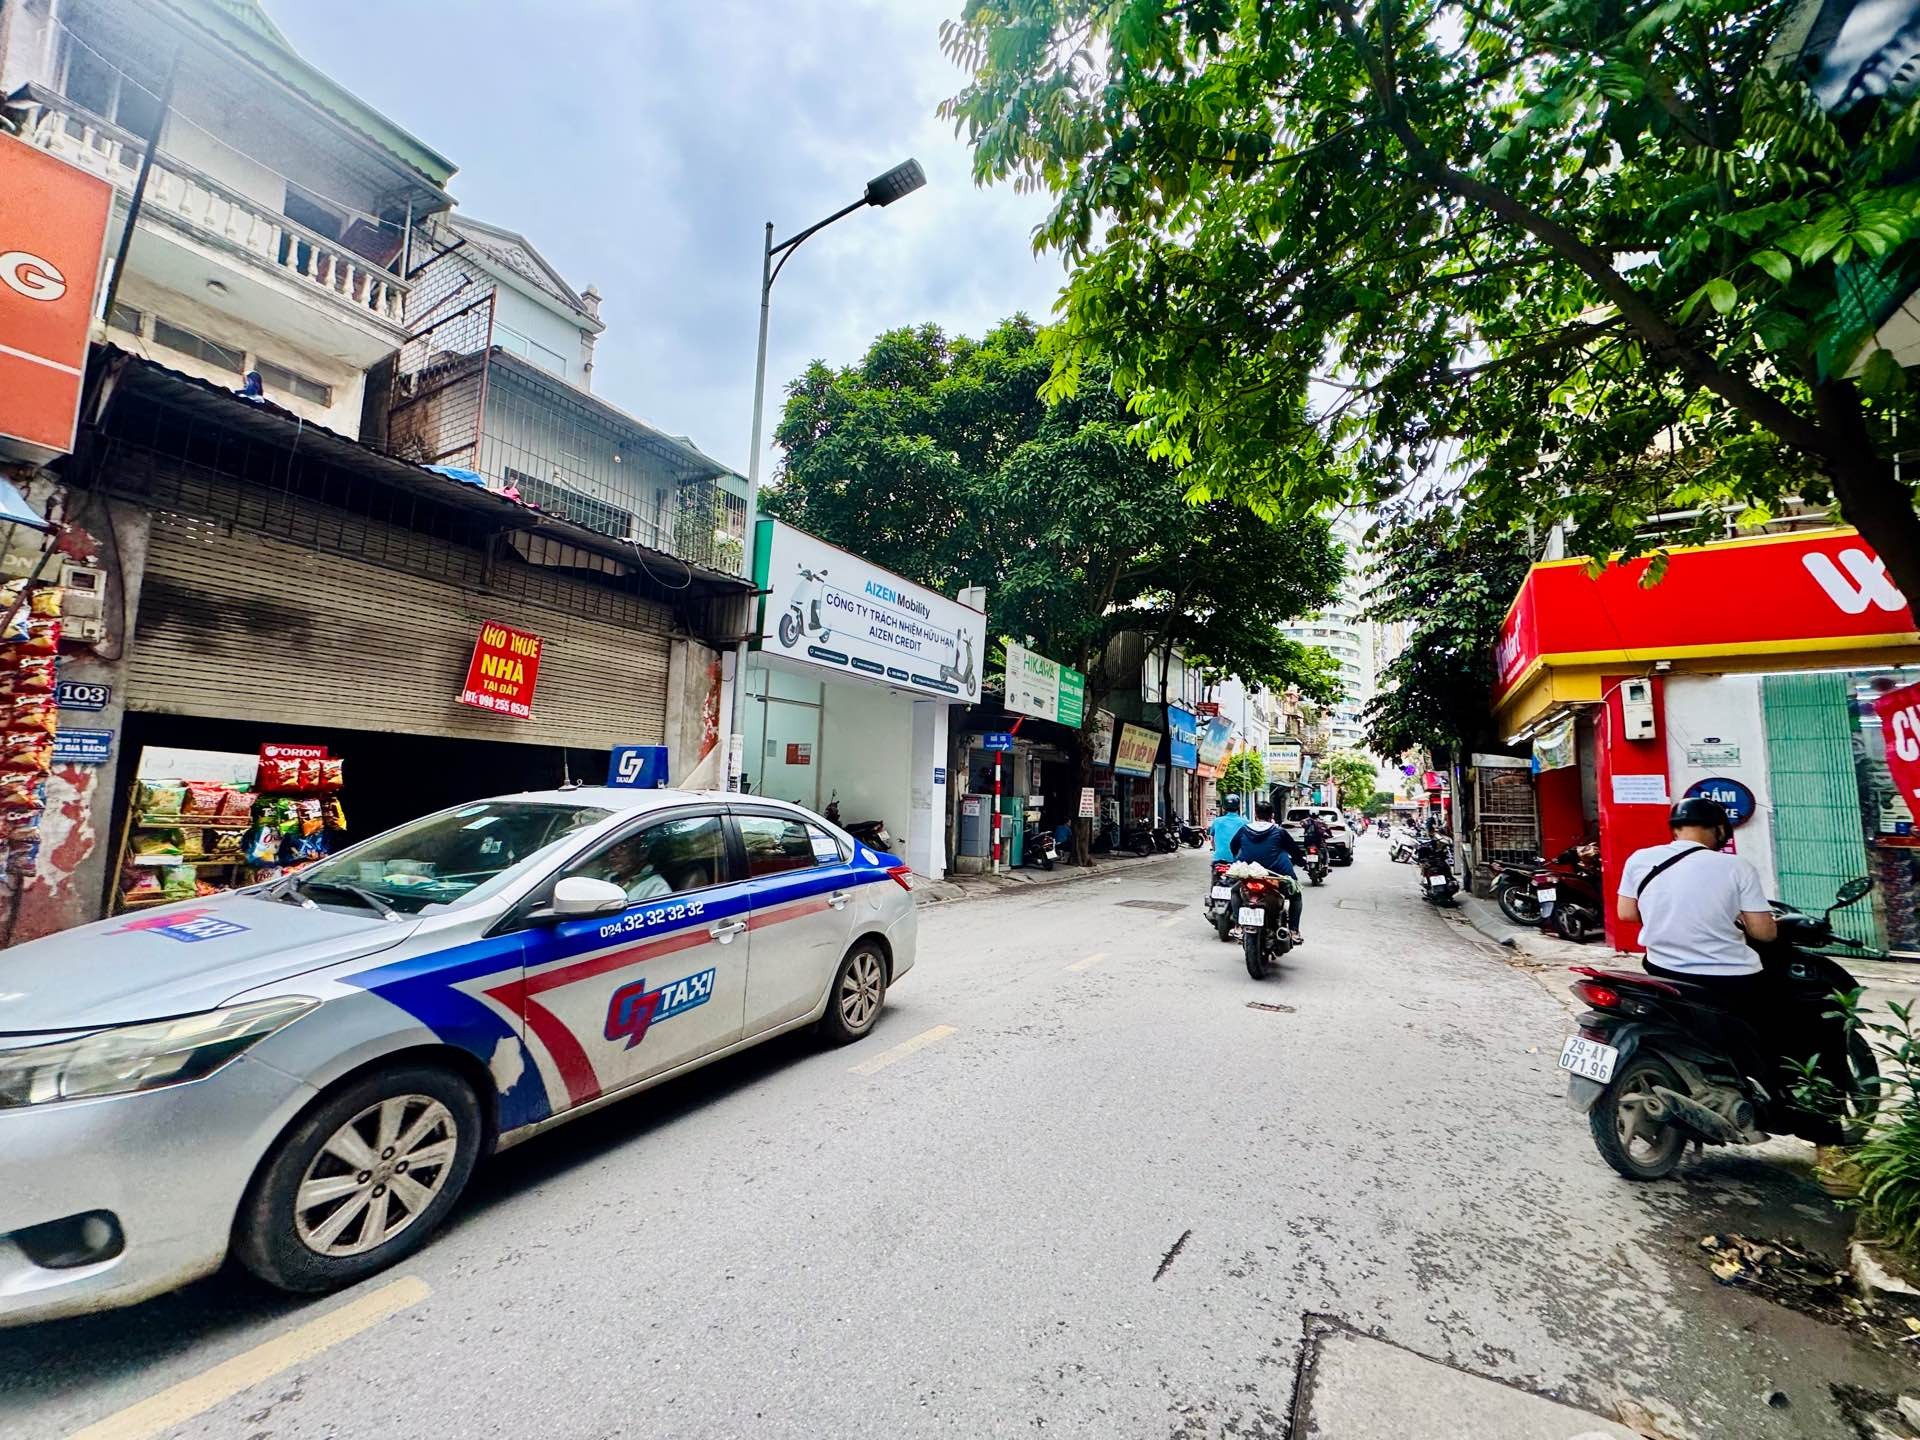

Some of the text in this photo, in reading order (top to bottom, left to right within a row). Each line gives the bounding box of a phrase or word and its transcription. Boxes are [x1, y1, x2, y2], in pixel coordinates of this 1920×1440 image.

[0, 251, 67, 301] G
[864, 579, 931, 620] AIZEN Mobility
[826, 592, 854, 613] CÔNG
[856, 603, 868, 617] TY
[870, 608, 898, 629] TRÁCH
[898, 620, 923, 638] NHIỆM
[940, 634, 955, 649] HẠN
[868, 625, 922, 652] AIZEN CREDIT
[480, 653, 524, 685] NHÀ
[61, 685, 106, 703] 103
[483, 679, 498, 693] TẠI
[281, 747, 321, 757] ORION
[647, 908, 666, 925] 32
[668, 905, 686, 920] 32
[687, 901, 705, 916] 32
[661, 970, 714, 1011] TAXI
[1569, 1039, 1608, 1062] 29-AY
[1561, 1053, 1609, 1079] 071.96
